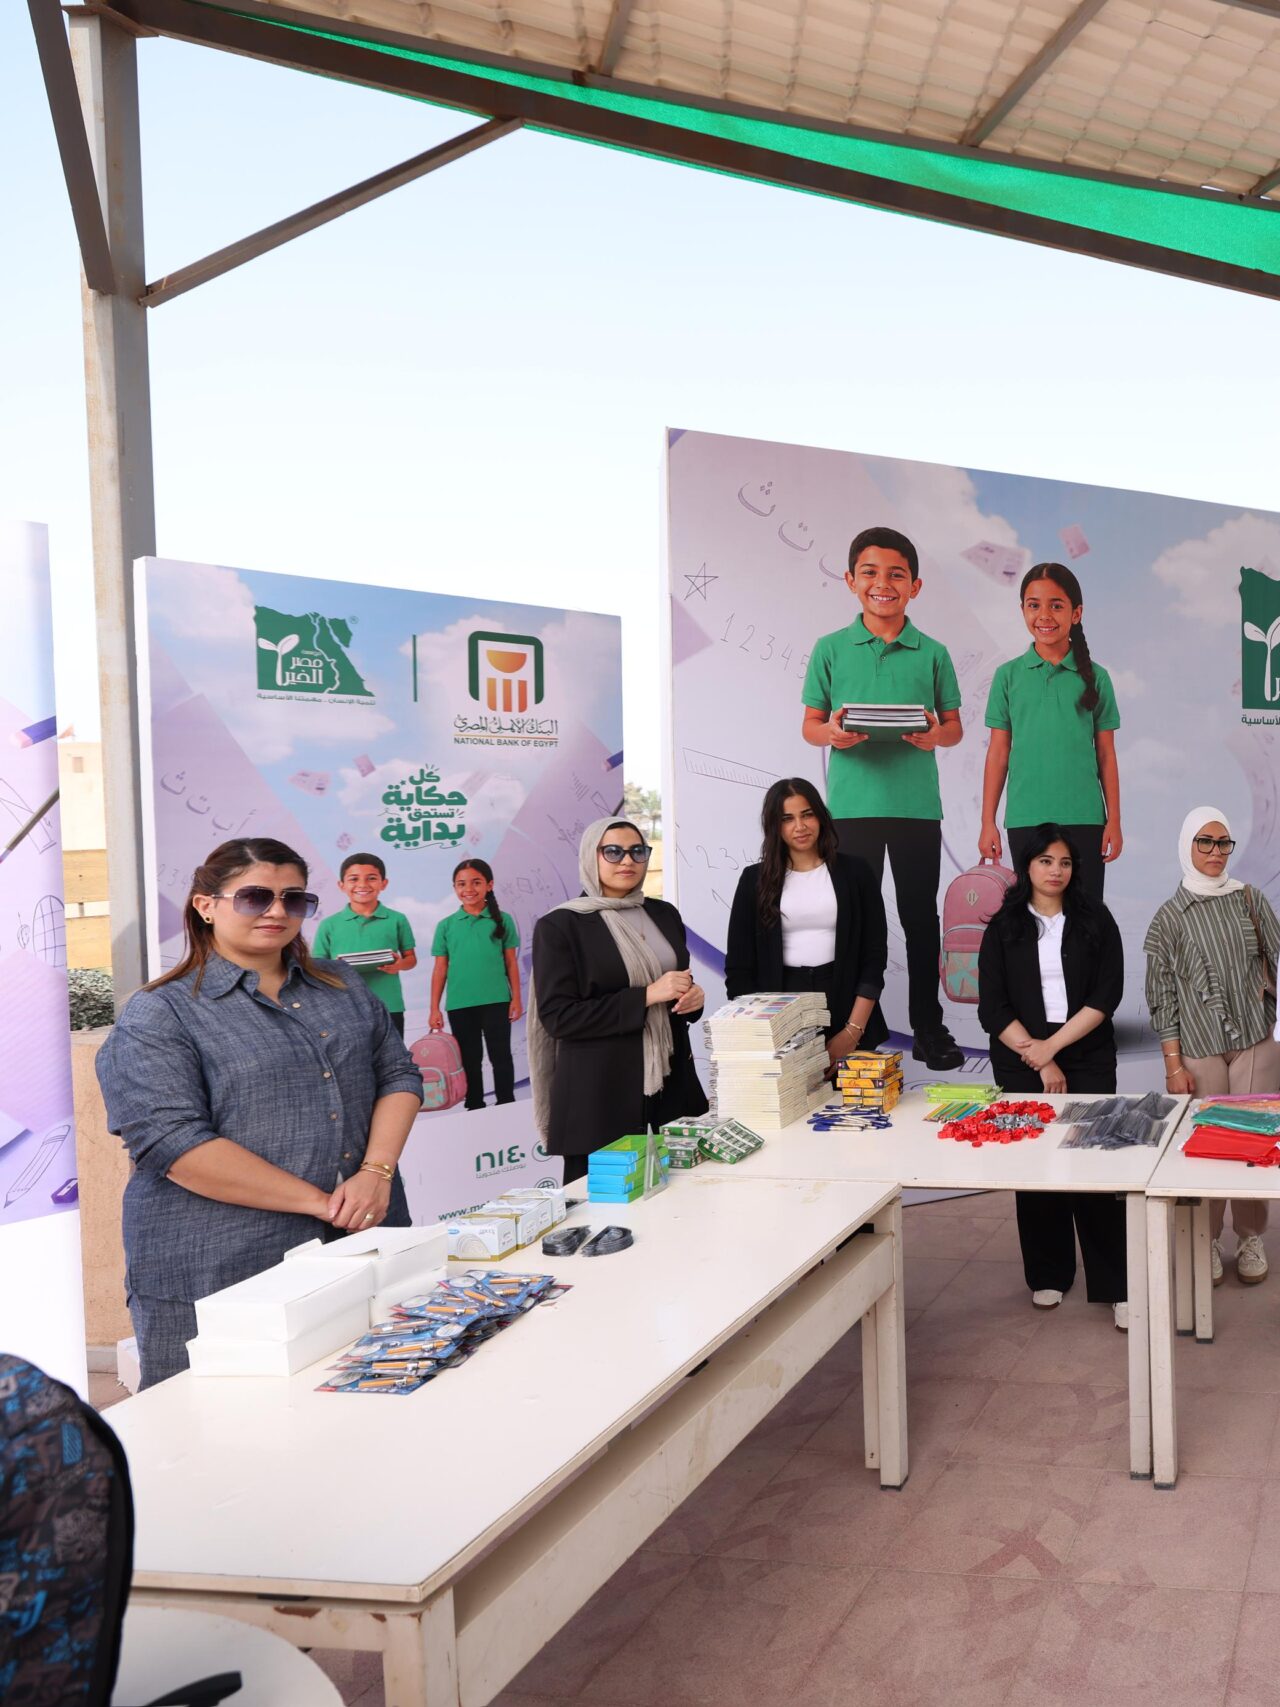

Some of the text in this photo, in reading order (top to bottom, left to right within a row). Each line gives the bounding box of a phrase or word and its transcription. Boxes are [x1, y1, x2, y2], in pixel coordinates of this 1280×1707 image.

[290, 657, 323, 669] مصر
[282, 669, 323, 687] الخير
[454, 737, 494, 746] NATIONAL
[497, 738, 519, 746] BANK
[533, 740, 558, 748] EGYPT
[408, 768, 441, 785] كل
[382, 784, 467, 812] حكاية
[408, 808, 455, 822] تستحق
[380, 817, 466, 847] بداية
